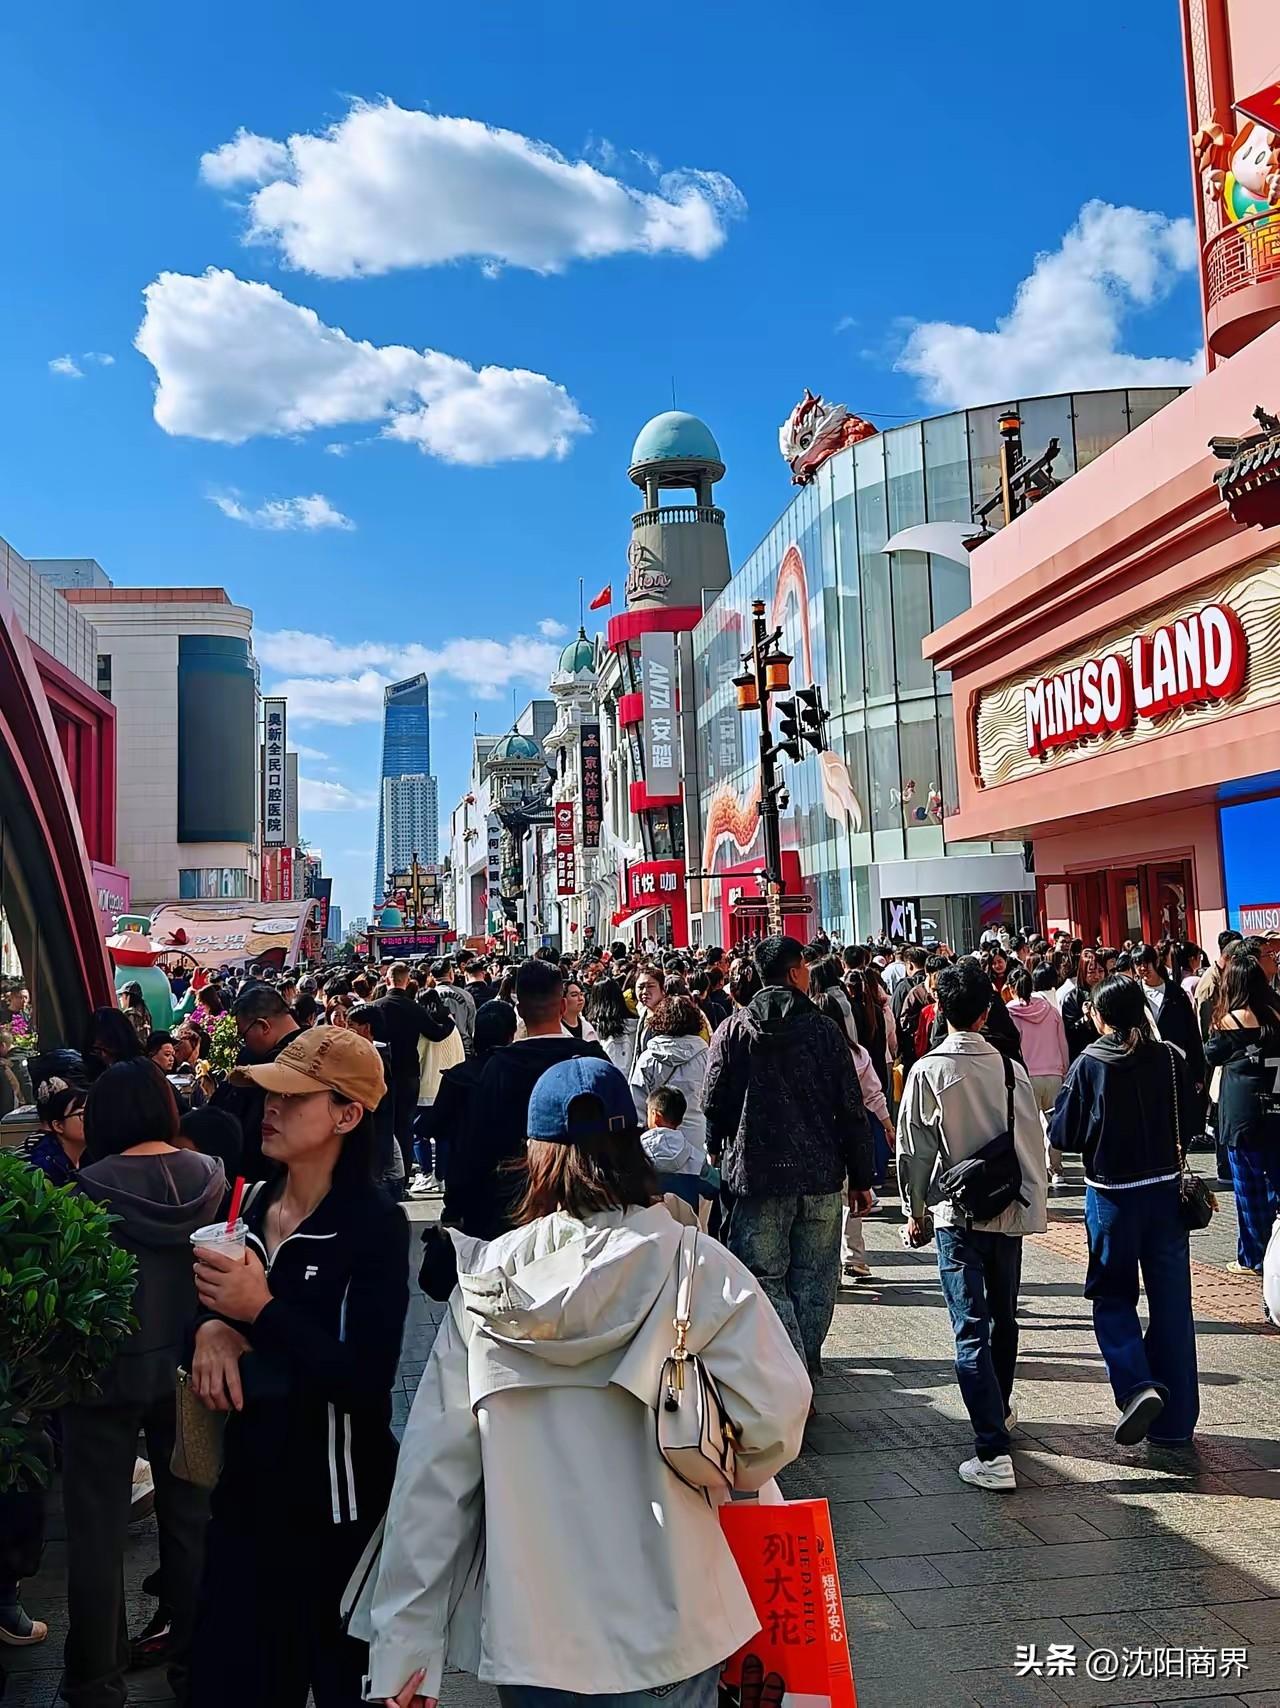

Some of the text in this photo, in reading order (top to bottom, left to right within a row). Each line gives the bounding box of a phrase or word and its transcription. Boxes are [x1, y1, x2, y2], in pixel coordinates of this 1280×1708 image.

[648, 660, 672, 768] ANTA 安踏
[1024, 604, 1238, 751] MINISO LAND
[267, 713, 282, 832] 奥新全民口腔医院
[1243, 909, 1279, 930] MINISO
[821, 1574, 844, 1643] 短保才安心
